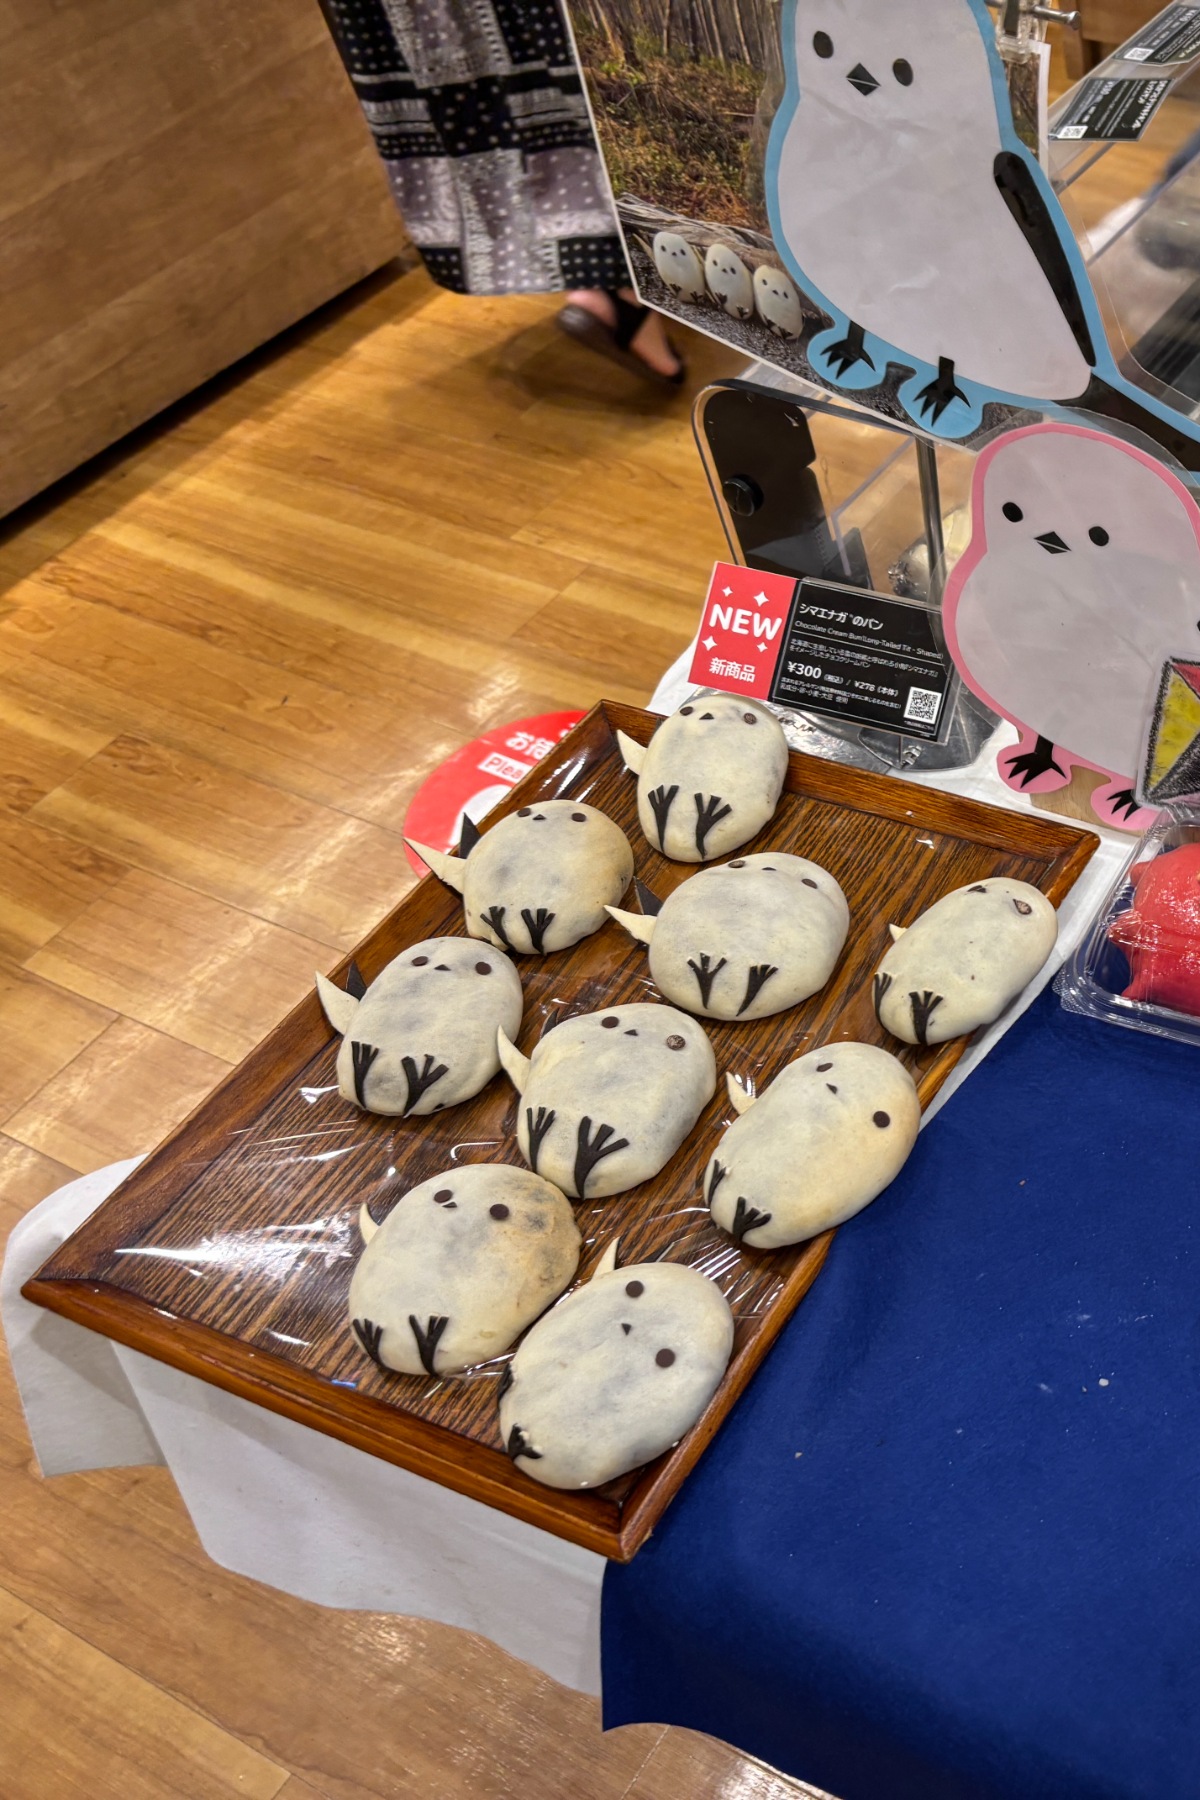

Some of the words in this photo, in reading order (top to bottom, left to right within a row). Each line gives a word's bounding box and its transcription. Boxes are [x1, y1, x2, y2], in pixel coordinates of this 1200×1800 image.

[708, 603, 783, 641] NEW
[709, 657, 756, 684] 新商品
[785, 660, 822, 680] ¥300
